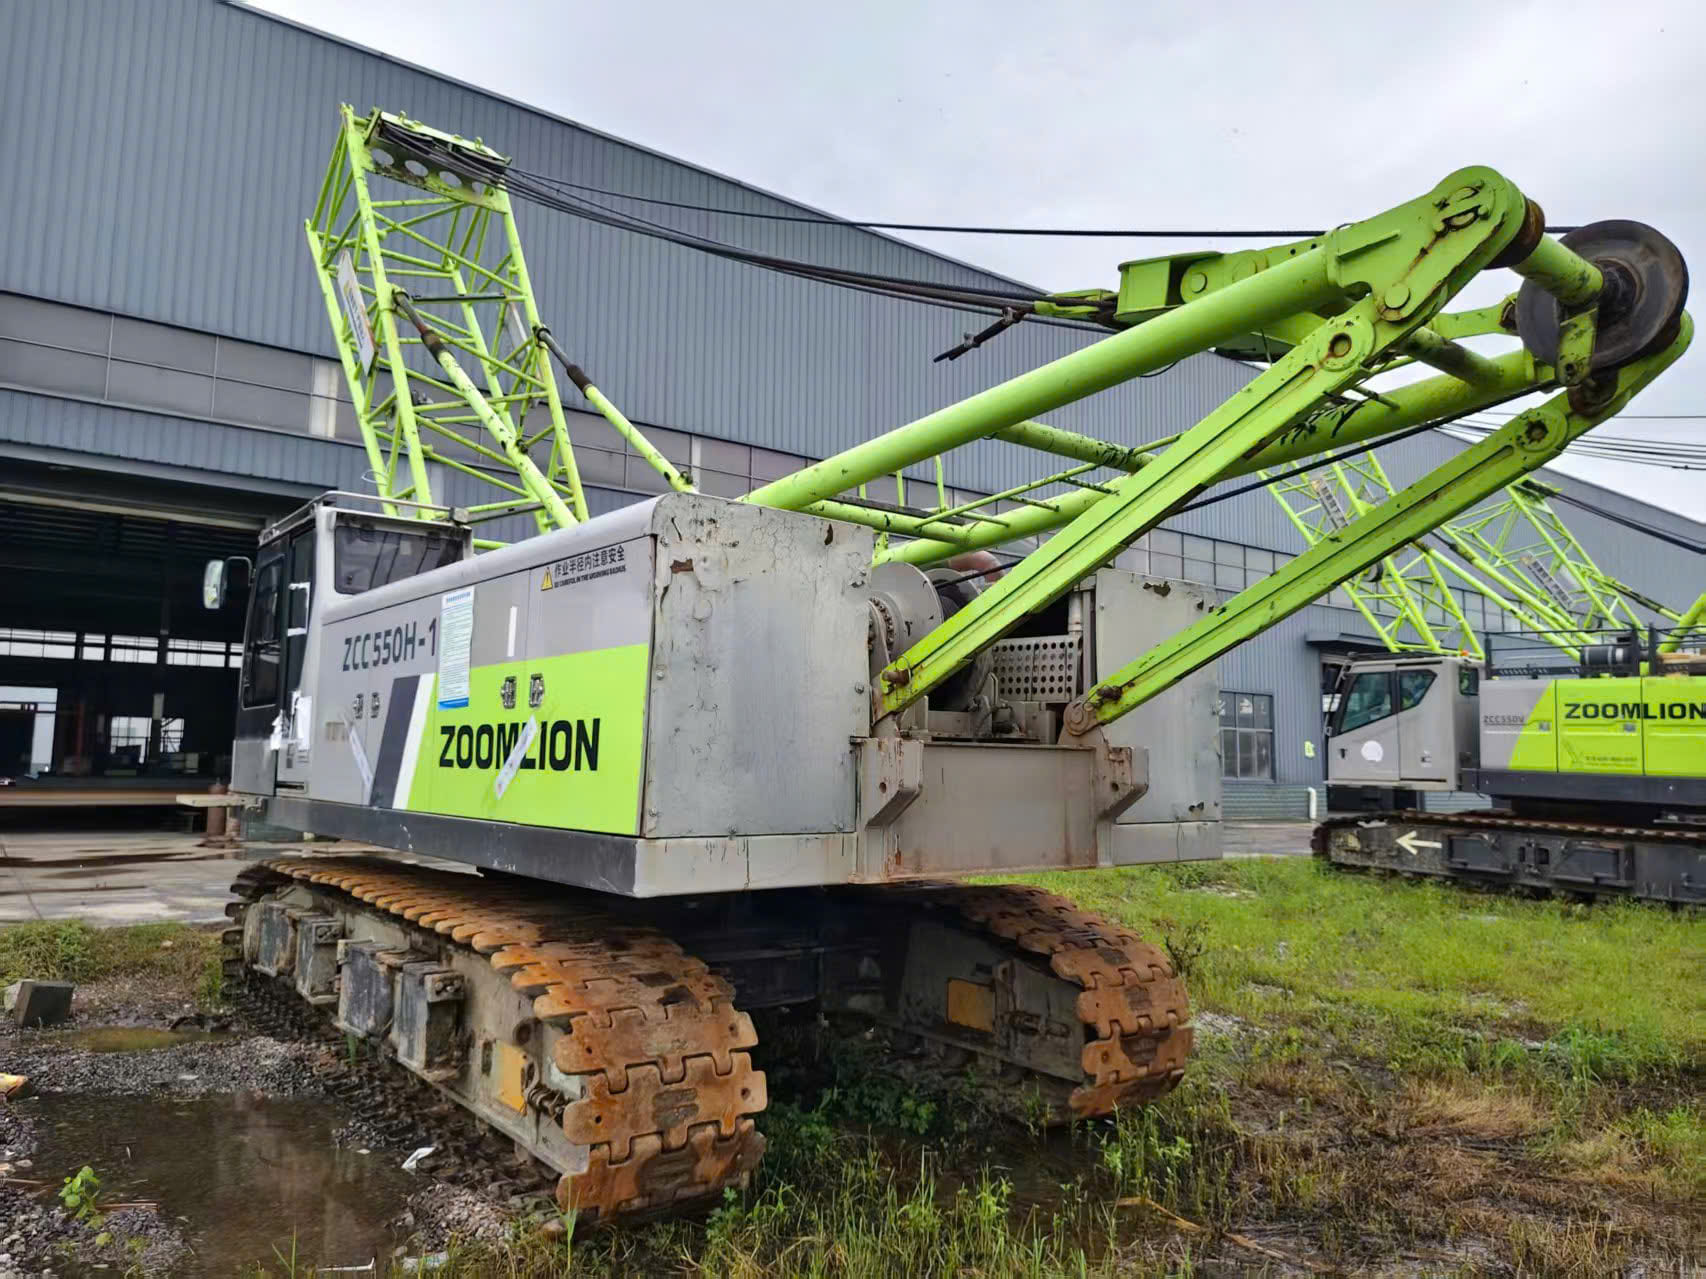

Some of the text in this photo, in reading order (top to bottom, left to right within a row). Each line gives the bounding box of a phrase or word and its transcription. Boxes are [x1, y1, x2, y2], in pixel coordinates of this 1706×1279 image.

[555, 545, 625, 577] 作业半径内注意安全
[342, 616, 437, 672] ZCC550H-1
[1564, 703, 1706, 719] ZOOMLION
